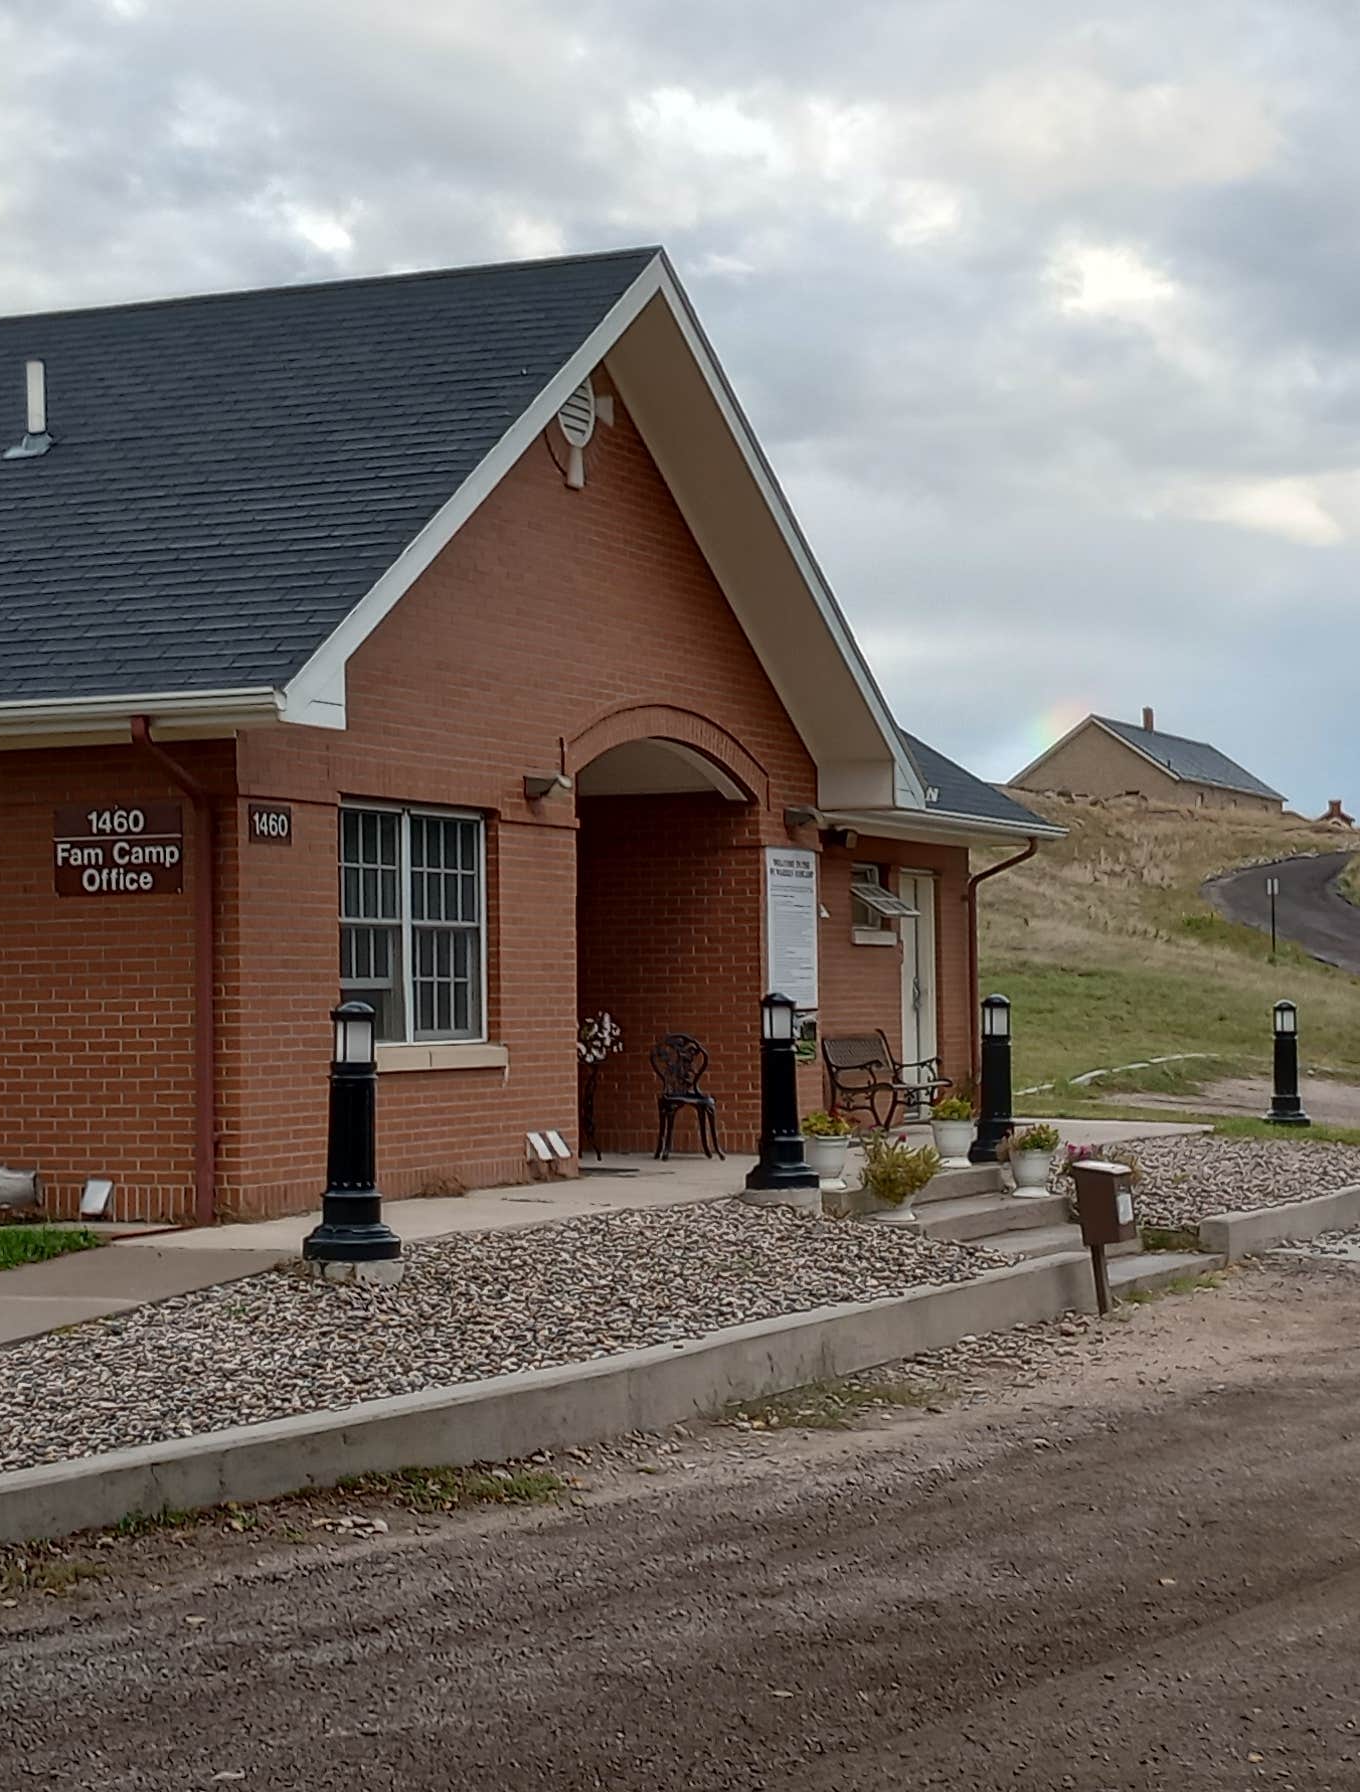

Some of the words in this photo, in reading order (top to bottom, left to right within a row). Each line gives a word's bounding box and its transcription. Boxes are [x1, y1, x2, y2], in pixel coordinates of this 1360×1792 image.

[87, 810, 145, 834] 1460
[253, 812, 289, 837] 1460
[56, 843, 103, 867] Fam
[112, 841, 180, 868] Camp
[82, 868, 153, 892] Office
